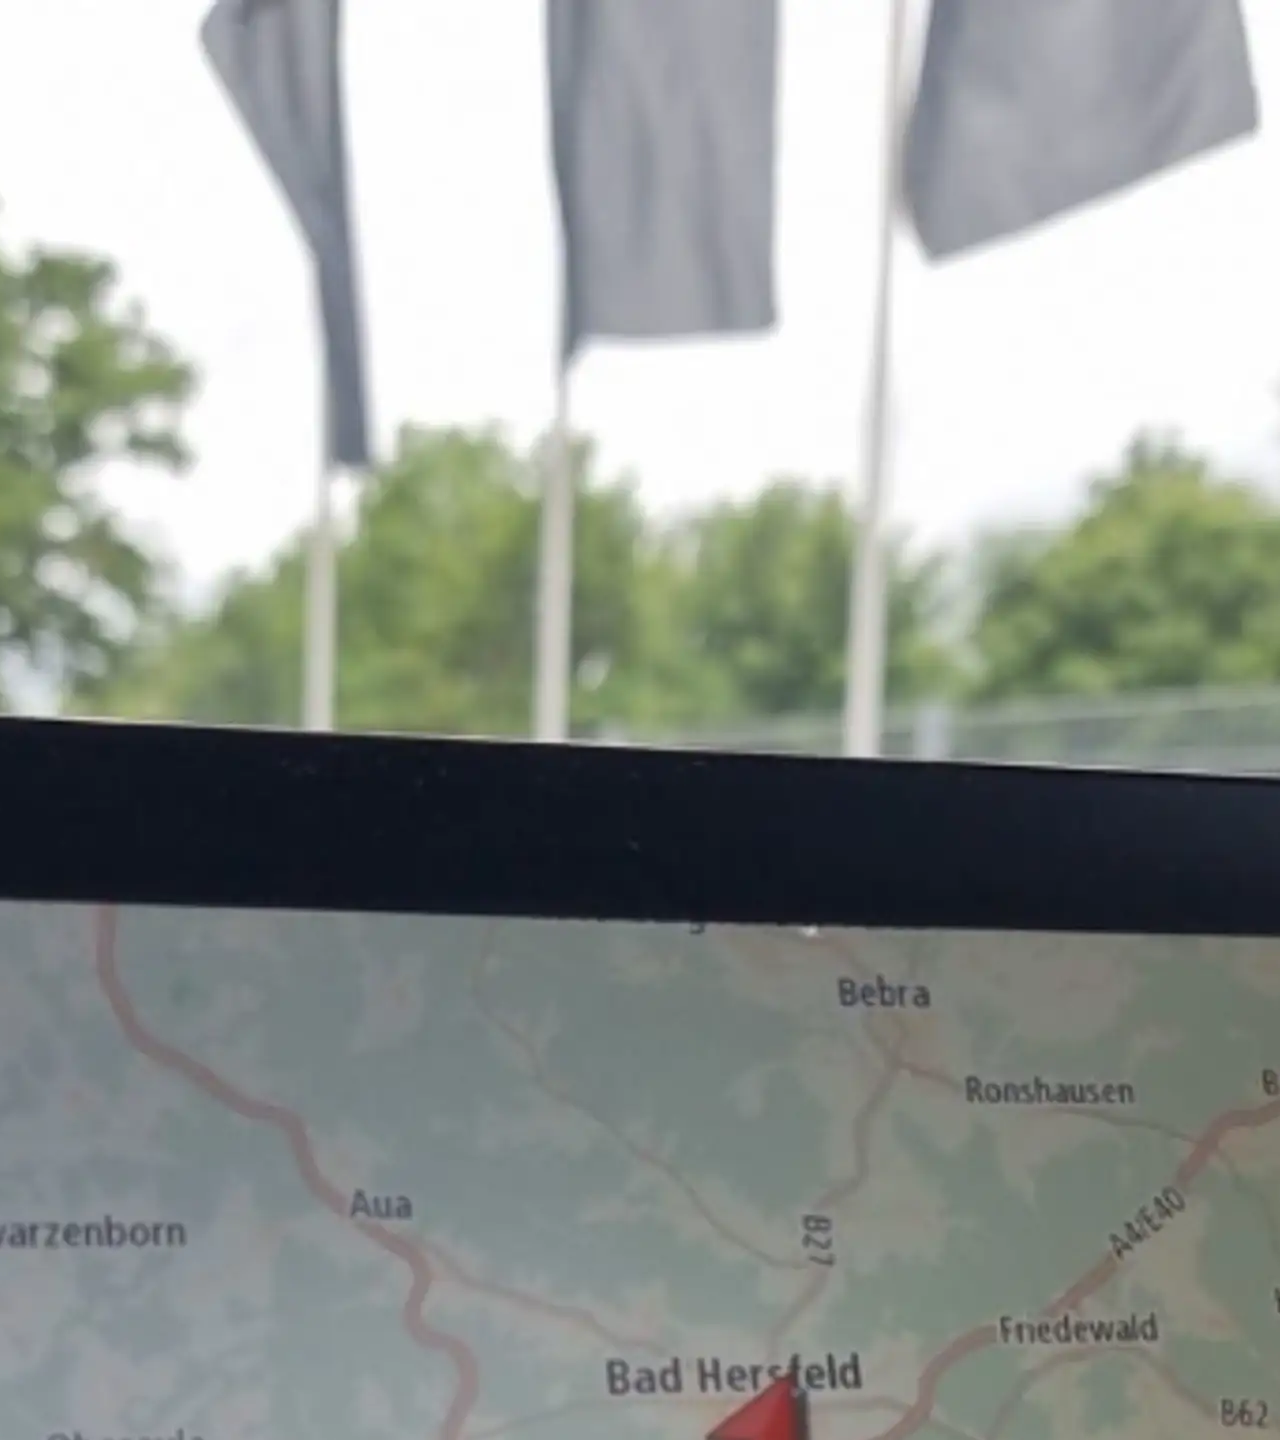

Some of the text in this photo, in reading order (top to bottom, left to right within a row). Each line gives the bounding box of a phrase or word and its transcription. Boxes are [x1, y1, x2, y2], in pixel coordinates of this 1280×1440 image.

[837, 976, 931, 1009] Bebra
[964, 1075, 1134, 1105] Ronshausen
[350, 1189, 413, 1220] Aua
[1108, 1185, 1188, 1261] A4/E40
[802, 1214, 835, 1268] B27
[999, 1313, 1159, 1344] Friedewald
[607, 1352, 863, 1395] Bad Hersfeld
[1221, 1399, 1269, 1428] B62
